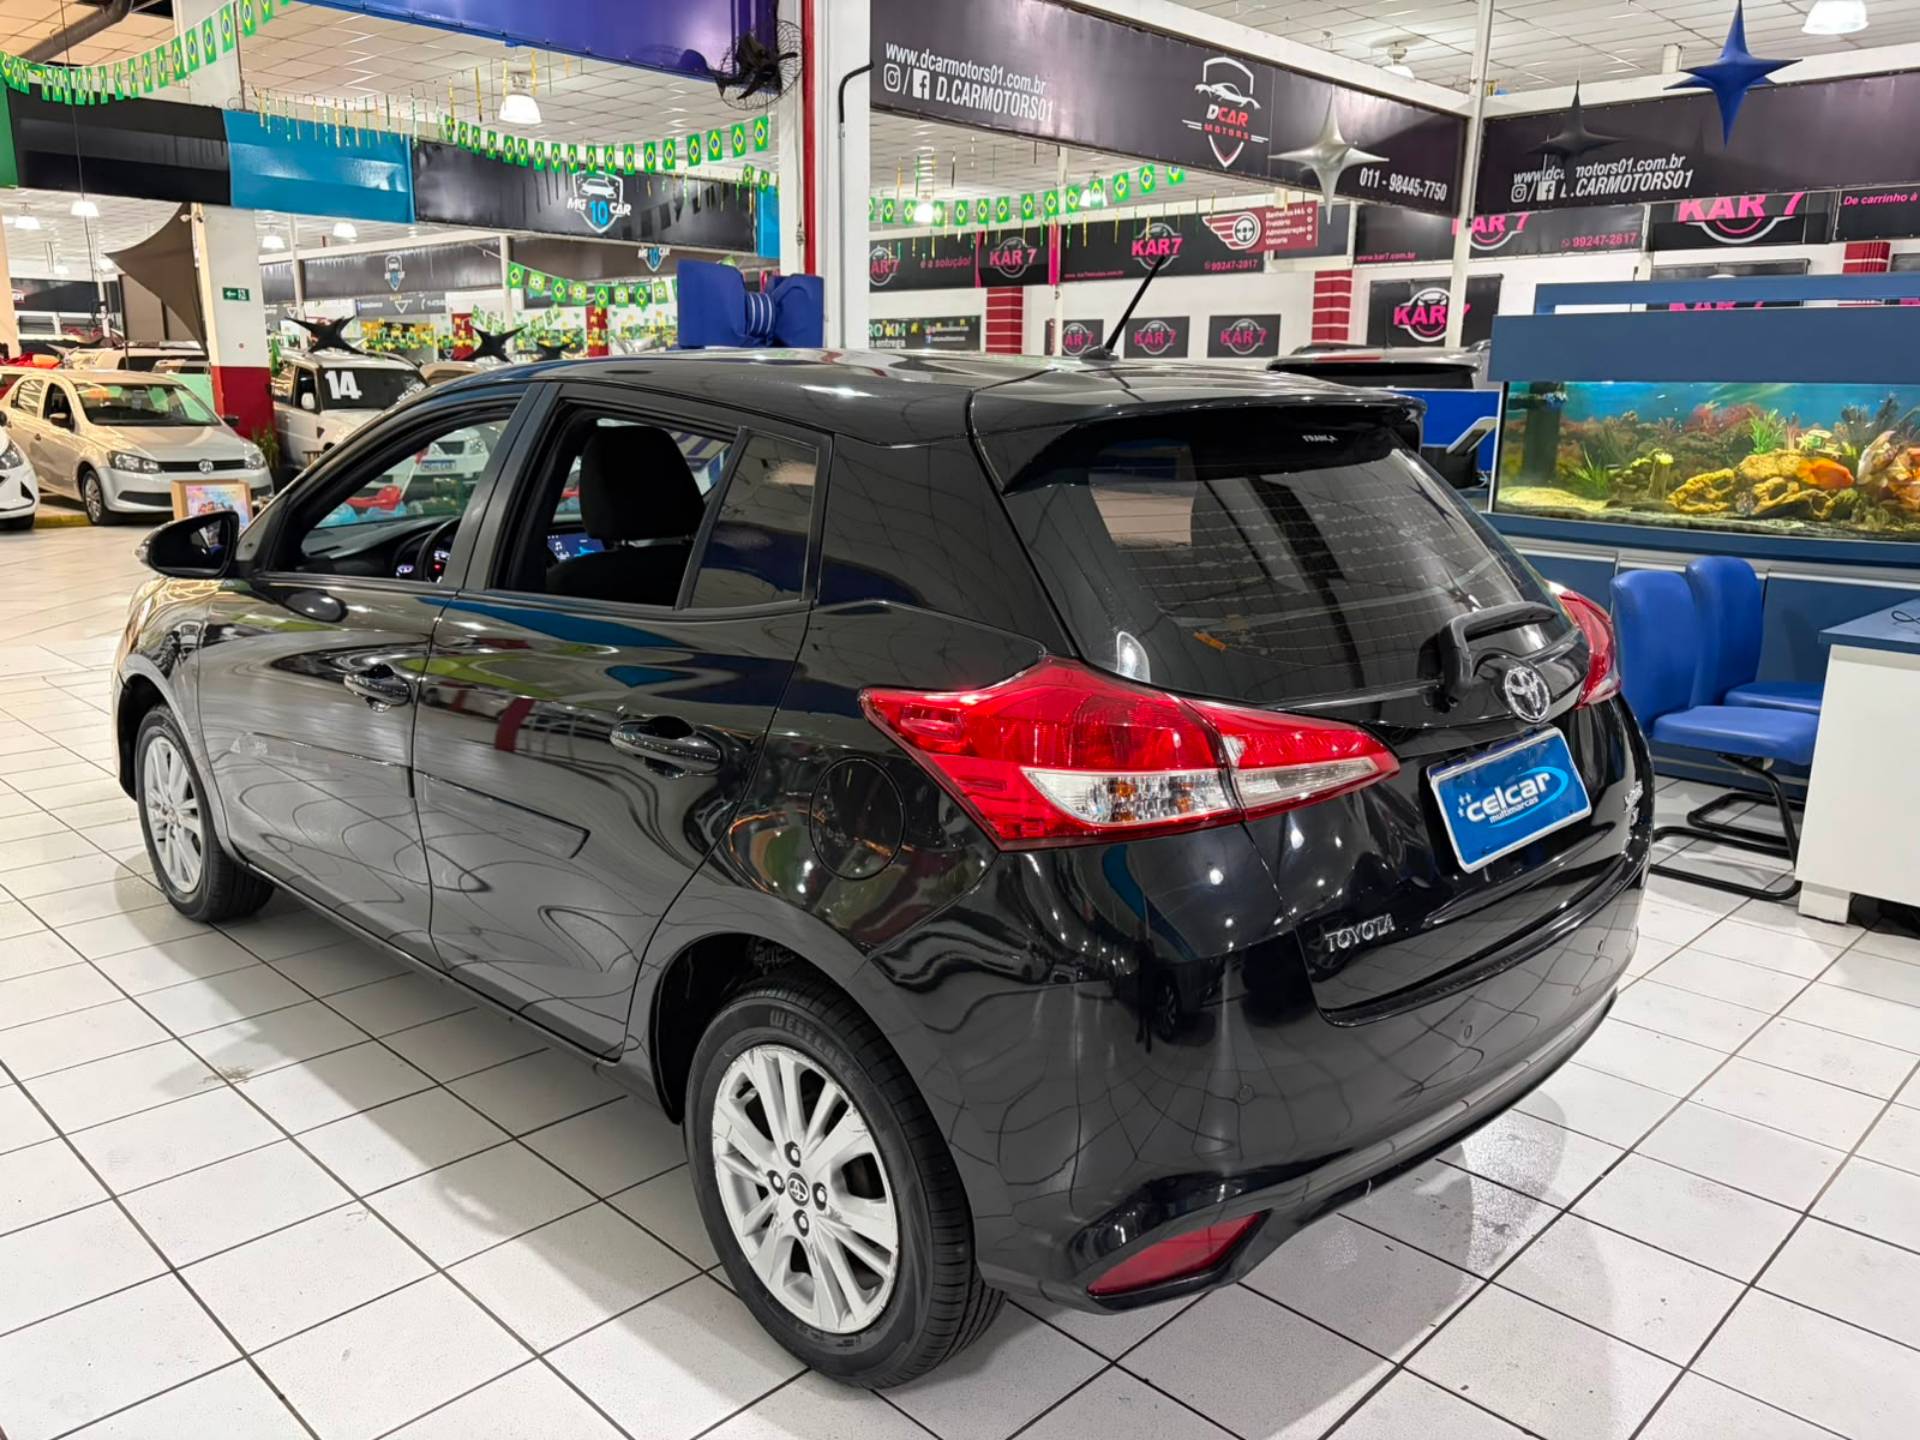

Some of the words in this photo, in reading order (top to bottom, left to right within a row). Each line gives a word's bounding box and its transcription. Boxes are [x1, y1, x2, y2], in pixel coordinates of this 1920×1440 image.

[886, 42, 1046, 96] www.dcarmotors01.com.br
[935, 76, 1054, 122] D.CARMOTORS01
[1206, 103, 1249, 127] DCAR
[1203, 123, 1249, 140] MOTORS
[1359, 167, 1380, 189] 011
[1388, 173, 1448, 201] 98445-7750
[567, 197, 587, 211] MG
[589, 200, 609, 225] 10
[609, 202, 632, 216] CAR
[1678, 193, 1767, 222] KAR
[1844, 196, 1859, 206] De
[1861, 193, 1908, 205] carrinho
[989, 249, 1023, 267] KAR
[1027, 248, 1038, 265] 7
[1131, 238, 1170, 256] KAR
[1171, 237, 1183, 255] 7
[871, 259, 889, 273] AR
[1393, 304, 1447, 326] KAR
[1065, 333, 1083, 347] AR
[1133, 330, 1165, 345] KAR
[1220, 329, 1253, 344] KAR
[325, 370, 363, 400] 14
[1466, 772, 1551, 822] celcar
[1324, 913, 1396, 953] TOYOTA
